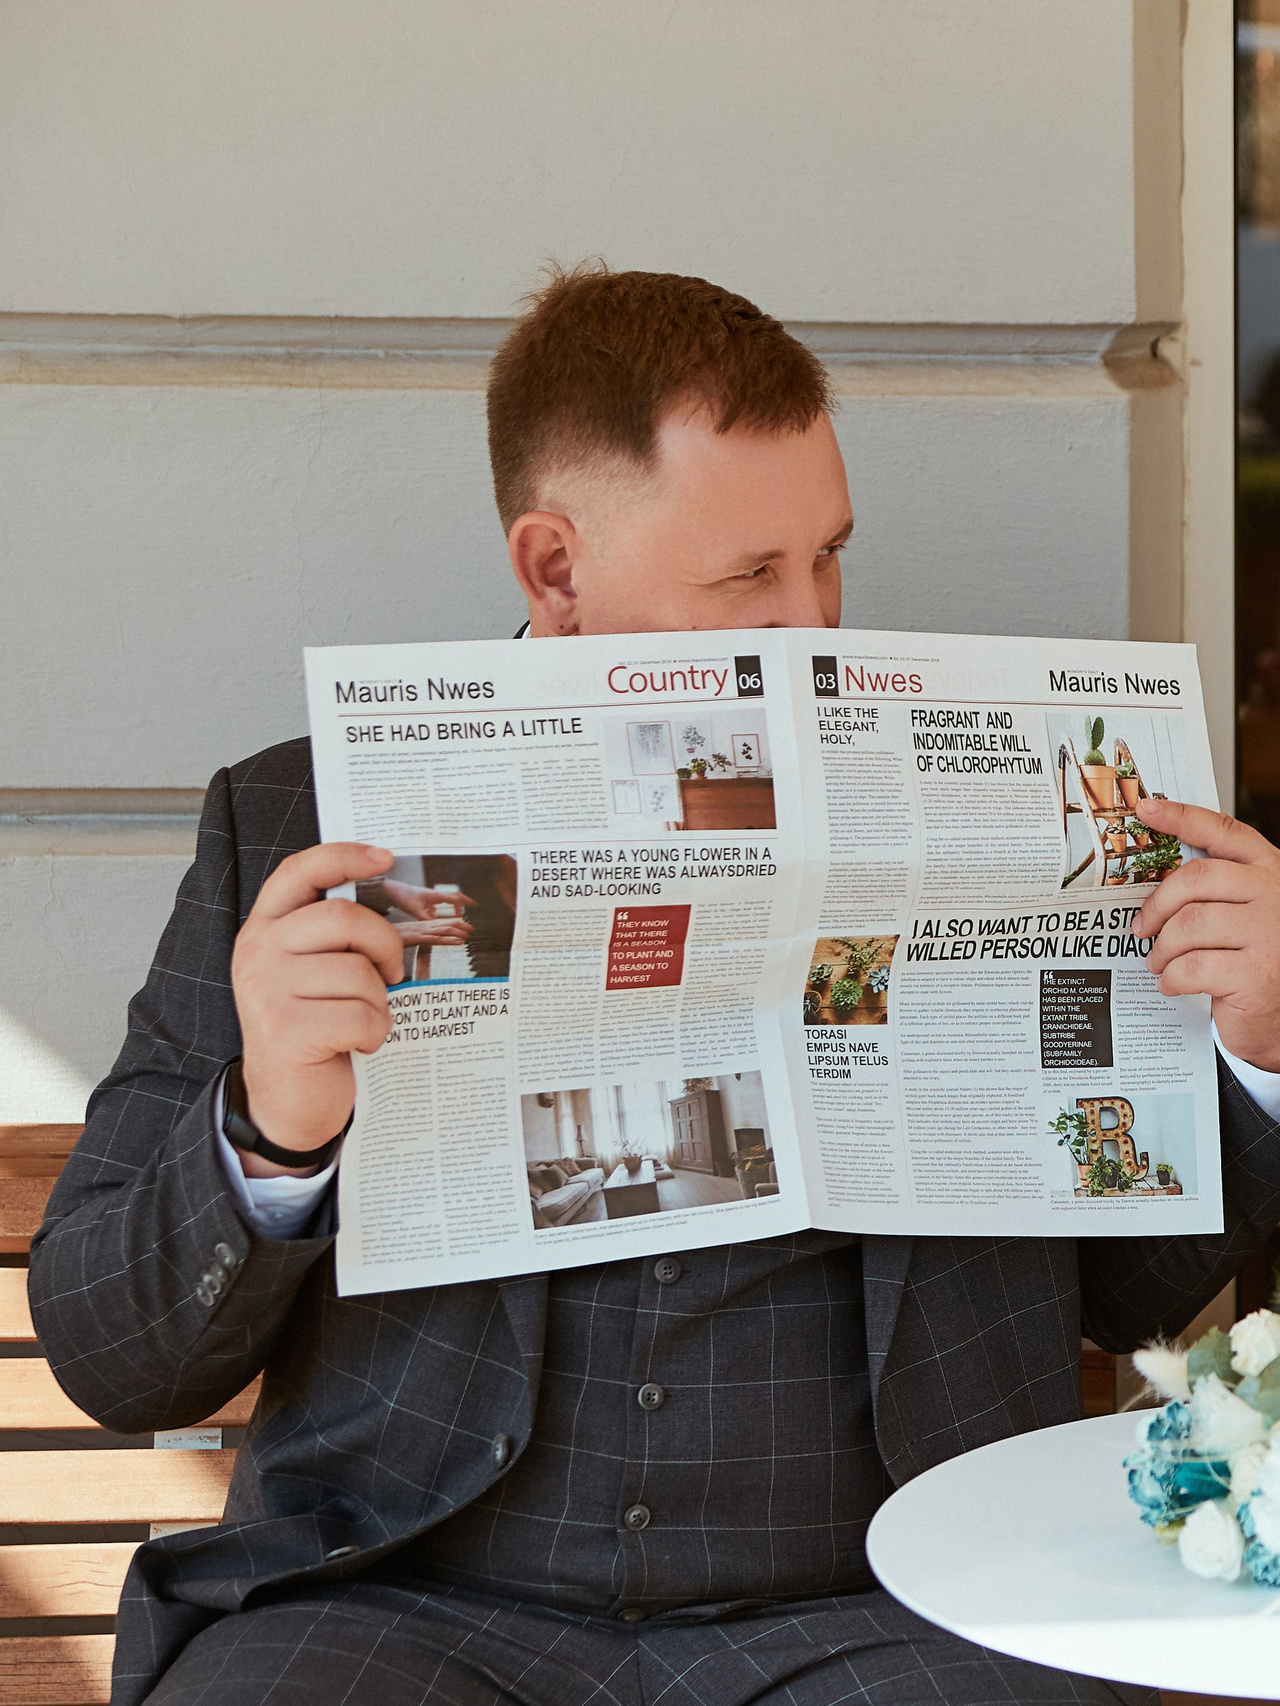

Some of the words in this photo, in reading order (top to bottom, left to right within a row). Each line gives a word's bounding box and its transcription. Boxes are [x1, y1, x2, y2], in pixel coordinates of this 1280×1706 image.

[608, 665, 728, 696] Country
[738, 673, 761, 689] 06
[815, 672, 837, 690] 03
[845, 665, 923, 693] Nwes
[1049, 670, 1118, 693] Mauris
[1125, 673, 1180, 696] Nwes
[335, 679, 418, 703] Mauris
[427, 678, 495, 700] Nwes
[817, 706, 821, 717] I
[824, 707, 851, 718] LIKE
[854, 708, 879, 718] THE
[911, 709, 980, 728] FRAGRANT
[986, 711, 1012, 729] AND
[346, 725, 384, 743] SHE
[391, 724, 430, 741] HAD
[437, 721, 496, 740] BRING
[502, 721, 516, 737] A
[521, 717, 583, 736] LITTLE
[819, 720, 879, 733] ELEGANT,
[820, 734, 855, 746] HOLY,
[913, 732, 998, 751] INDOMITABLE
[999, 734, 1031, 752] WILL
[917, 755, 933, 772] OF
[937, 755, 1043, 774] CHLOROPHYTUM
[530, 850, 578, 864] THERE
[582, 849, 613, 863] WAS
[617, 849, 627, 862] A
[631, 848, 679, 862] YOUNG
[684, 847, 741, 861] FLOWER
[745, 847, 758, 860] IN
[762, 847, 772, 860] A
[532, 867, 587, 881] DESERT
[591, 866, 641, 880] WHERE
[646, 865, 676, 879] WAS
[680, 864, 777, 878] ALWAYSDRIED
[531, 885, 561, 898] AND
[565, 882, 661, 897] SAD-LOOKING
[912, 920, 919, 939] I
[919, 919, 973, 939] ALSO
[978, 916, 1033, 936] WANT
[1037, 913, 1060, 933] TO
[1063, 910, 1090, 931] BE
[1091, 910, 1105, 930] A
[907, 940, 977, 962] WILLED
[980, 936, 1059, 960] PERSON
[1062, 935, 1104, 958] LIKE
[1107, 933, 1158, 958] DIAO
[610, 974, 651, 983] HARVEST
[1043, 978, 1057, 986] THE
[388, 993, 422, 1010] KNOW
[425, 990, 455, 1005] THAT
[457, 989, 497, 1002] THERE
[500, 988, 510, 1000] IS
[804, 1029, 847, 1039] TORASI
[806, 1042, 846, 1053] EMPUS
[849, 1042, 879, 1053] NAVE
[1043, 1050, 1082, 1058] (SUBFAMILY
[808, 1055, 850, 1066] LIPSUM
[852, 1056, 889, 1066] TELUS
[809, 1068, 851, 1079] TERDIM
